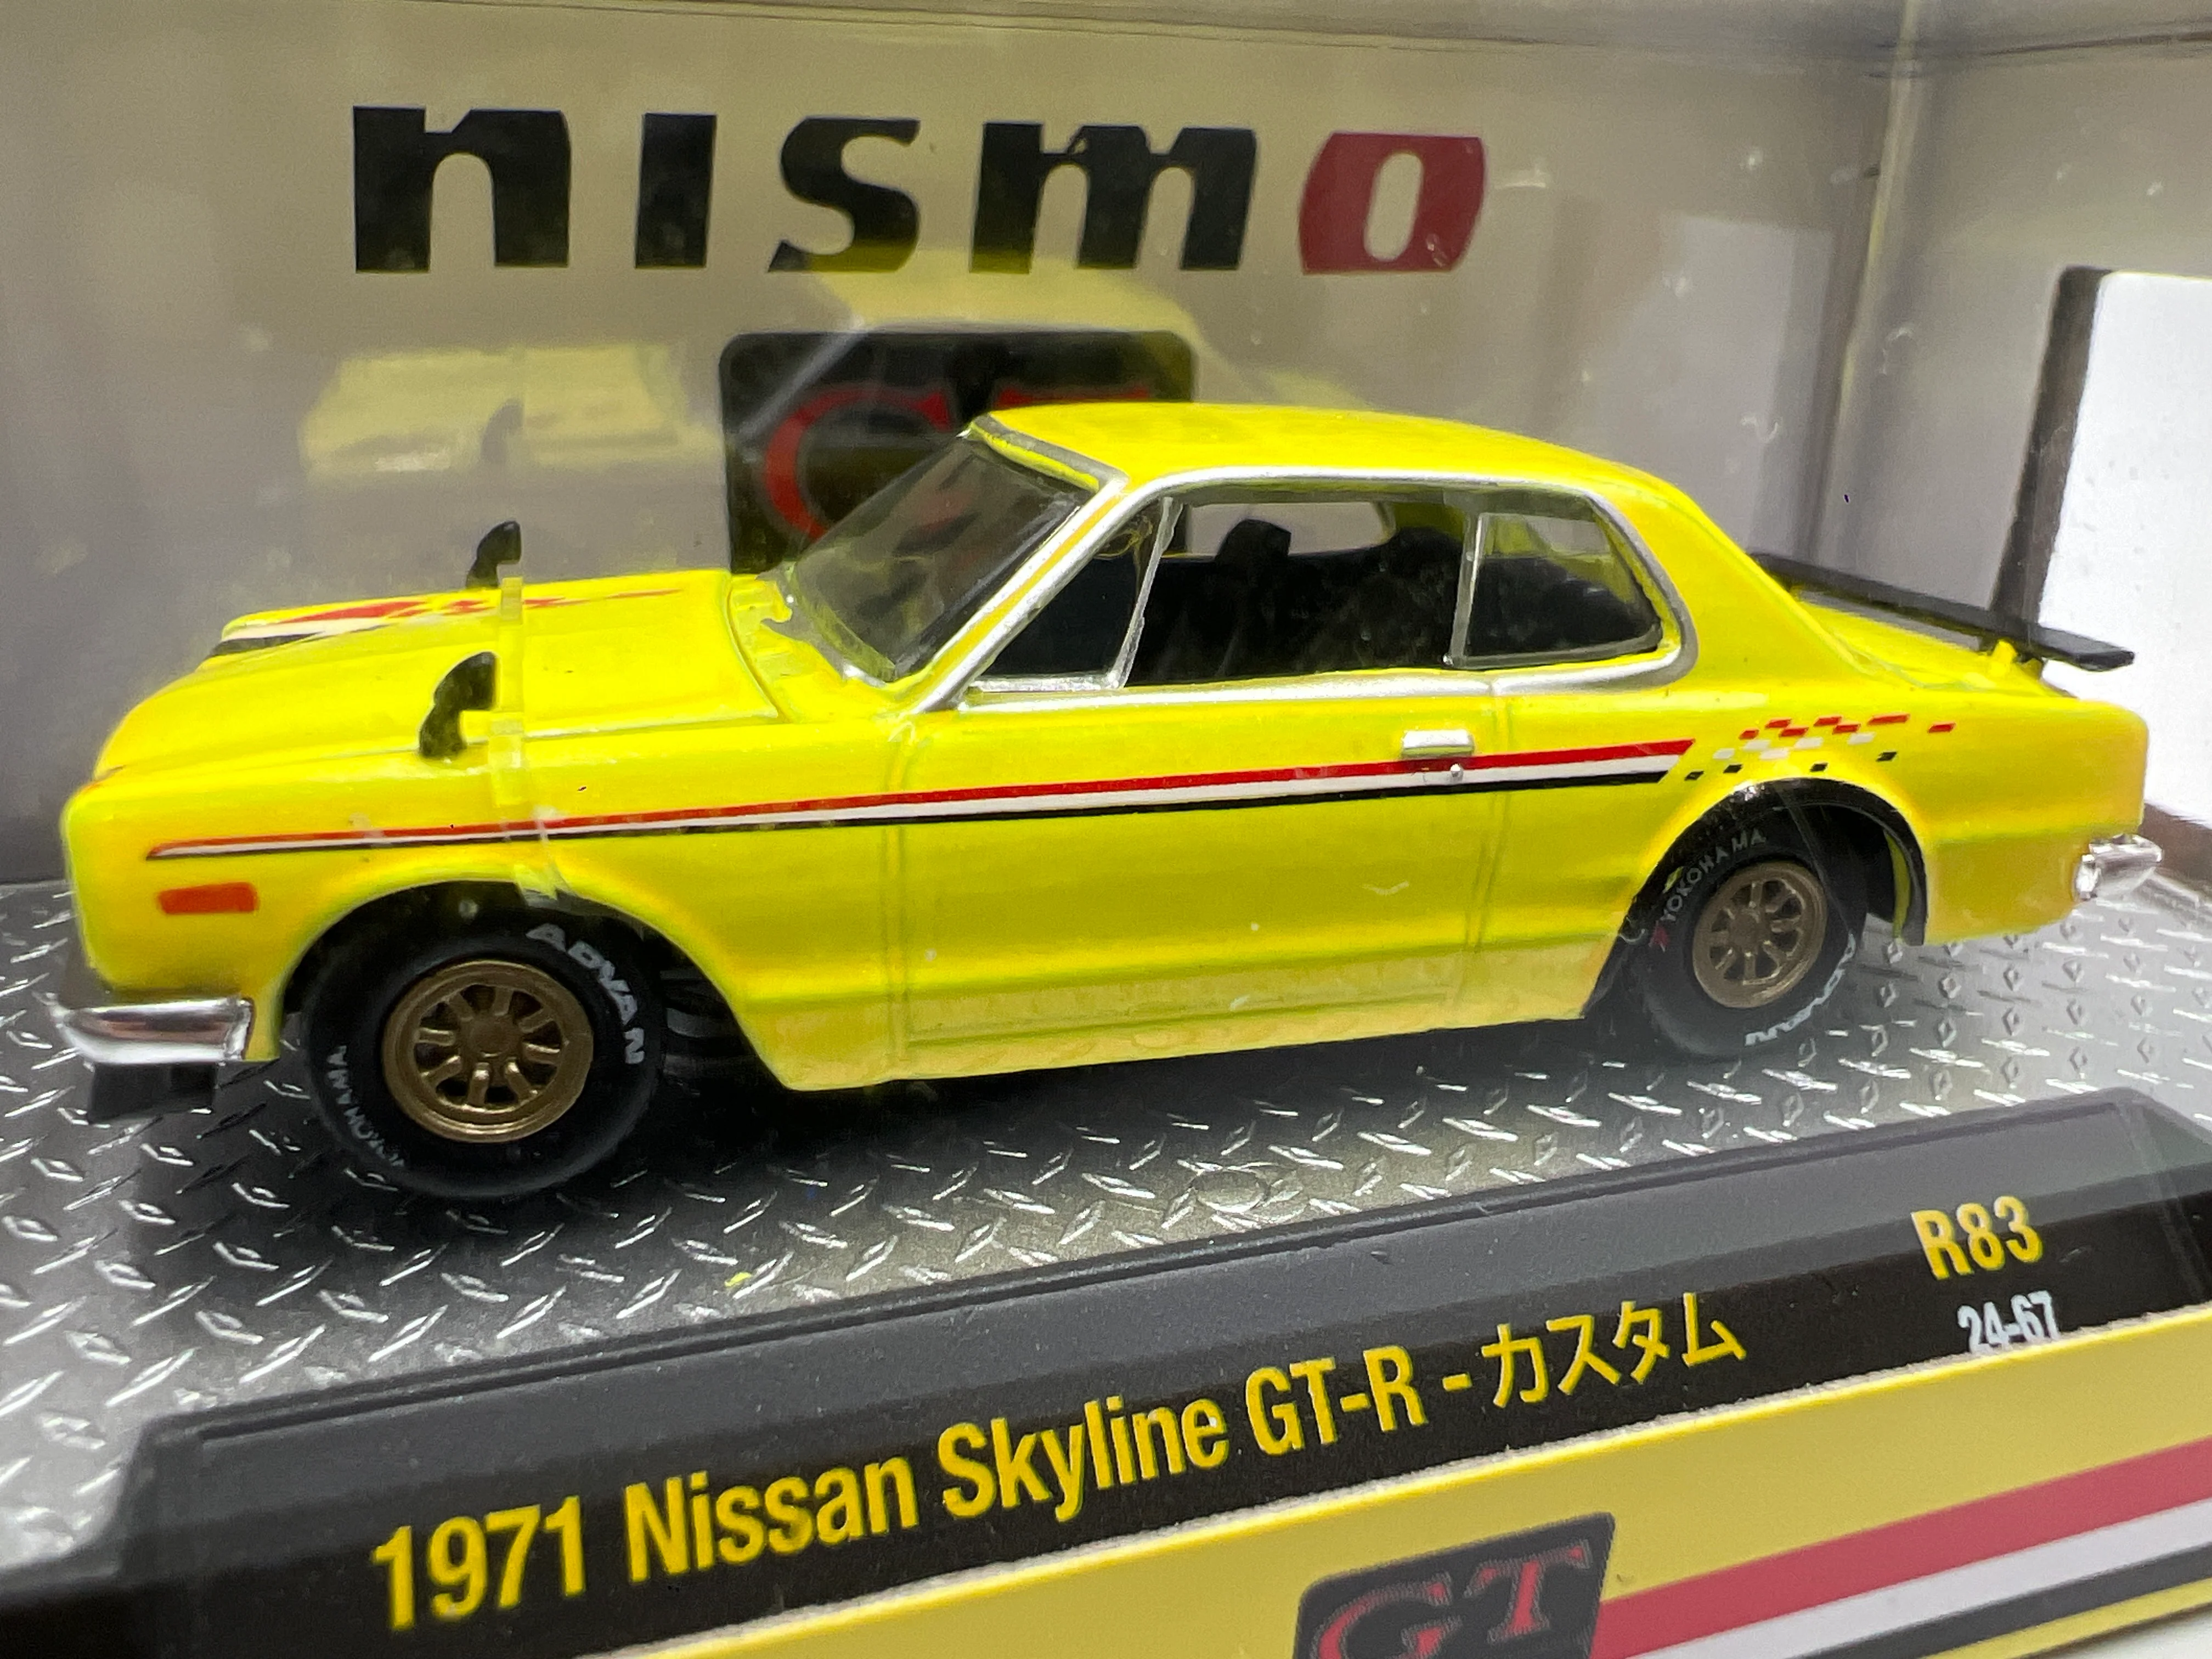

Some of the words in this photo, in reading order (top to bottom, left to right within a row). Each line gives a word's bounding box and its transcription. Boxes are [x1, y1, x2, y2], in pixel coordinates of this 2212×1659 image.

[352, 105, 1486, 274] nismo
[1660, 828, 1767, 922] YOKOHAMA
[526, 923, 645, 1065] ADVAN
[1910, 1195, 2044, 1280] R83
[1956, 1290, 2061, 1355] 24-67
[371, 1495, 585, 1630] 1971
[623, 1455, 919, 1583] Nissan
[936, 1396, 1230, 1523] Skyline
[1244, 1345, 1427, 1456] GT-R
[1481, 1291, 1747, 1409] カスタム
